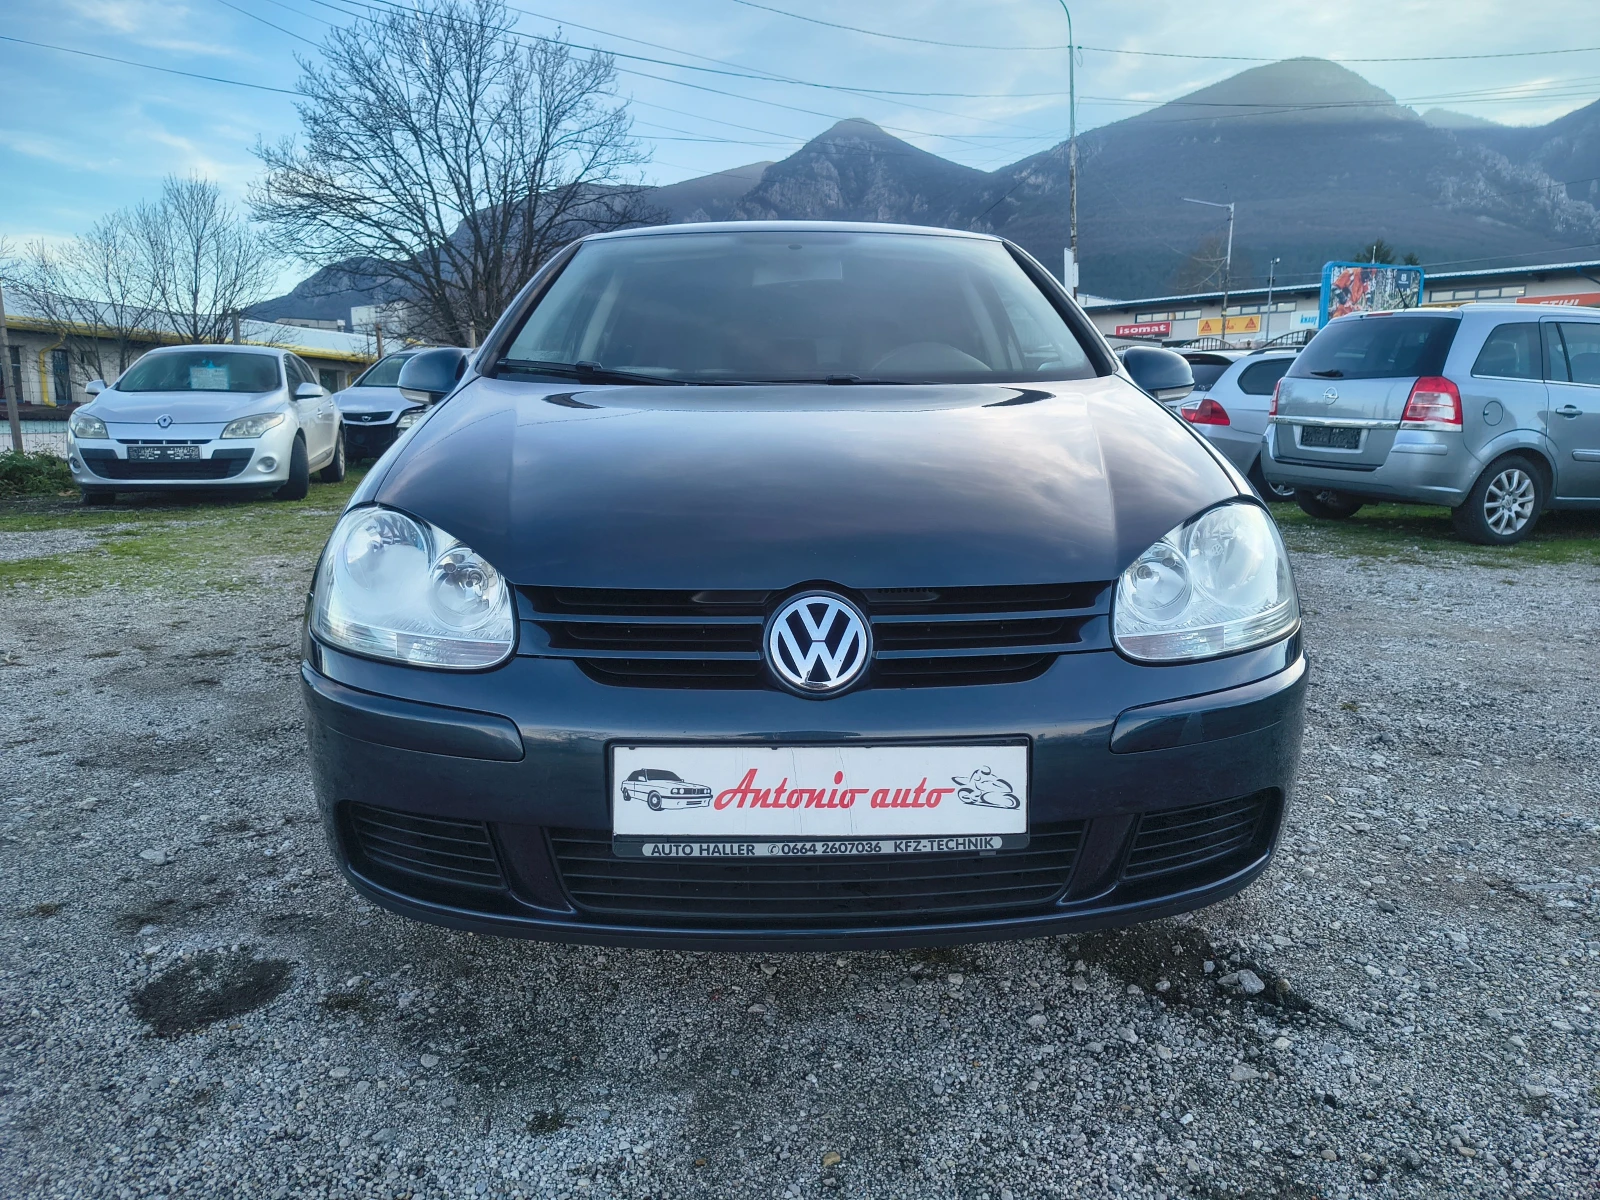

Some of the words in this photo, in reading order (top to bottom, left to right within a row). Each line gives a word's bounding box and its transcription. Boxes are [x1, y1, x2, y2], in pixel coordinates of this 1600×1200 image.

[1119, 324, 1167, 335] isomat
[771, 597, 866, 688] VW
[713, 768, 869, 811] Antonio
[870, 777, 956, 809] auto
[651, 844, 694, 856] AUTO
[699, 844, 756, 856] HALLER
[781, 843, 818, 855] 0664
[821, 841, 882, 854] 2607036
[893, 837, 995, 853] KFZ-TECHNIK
